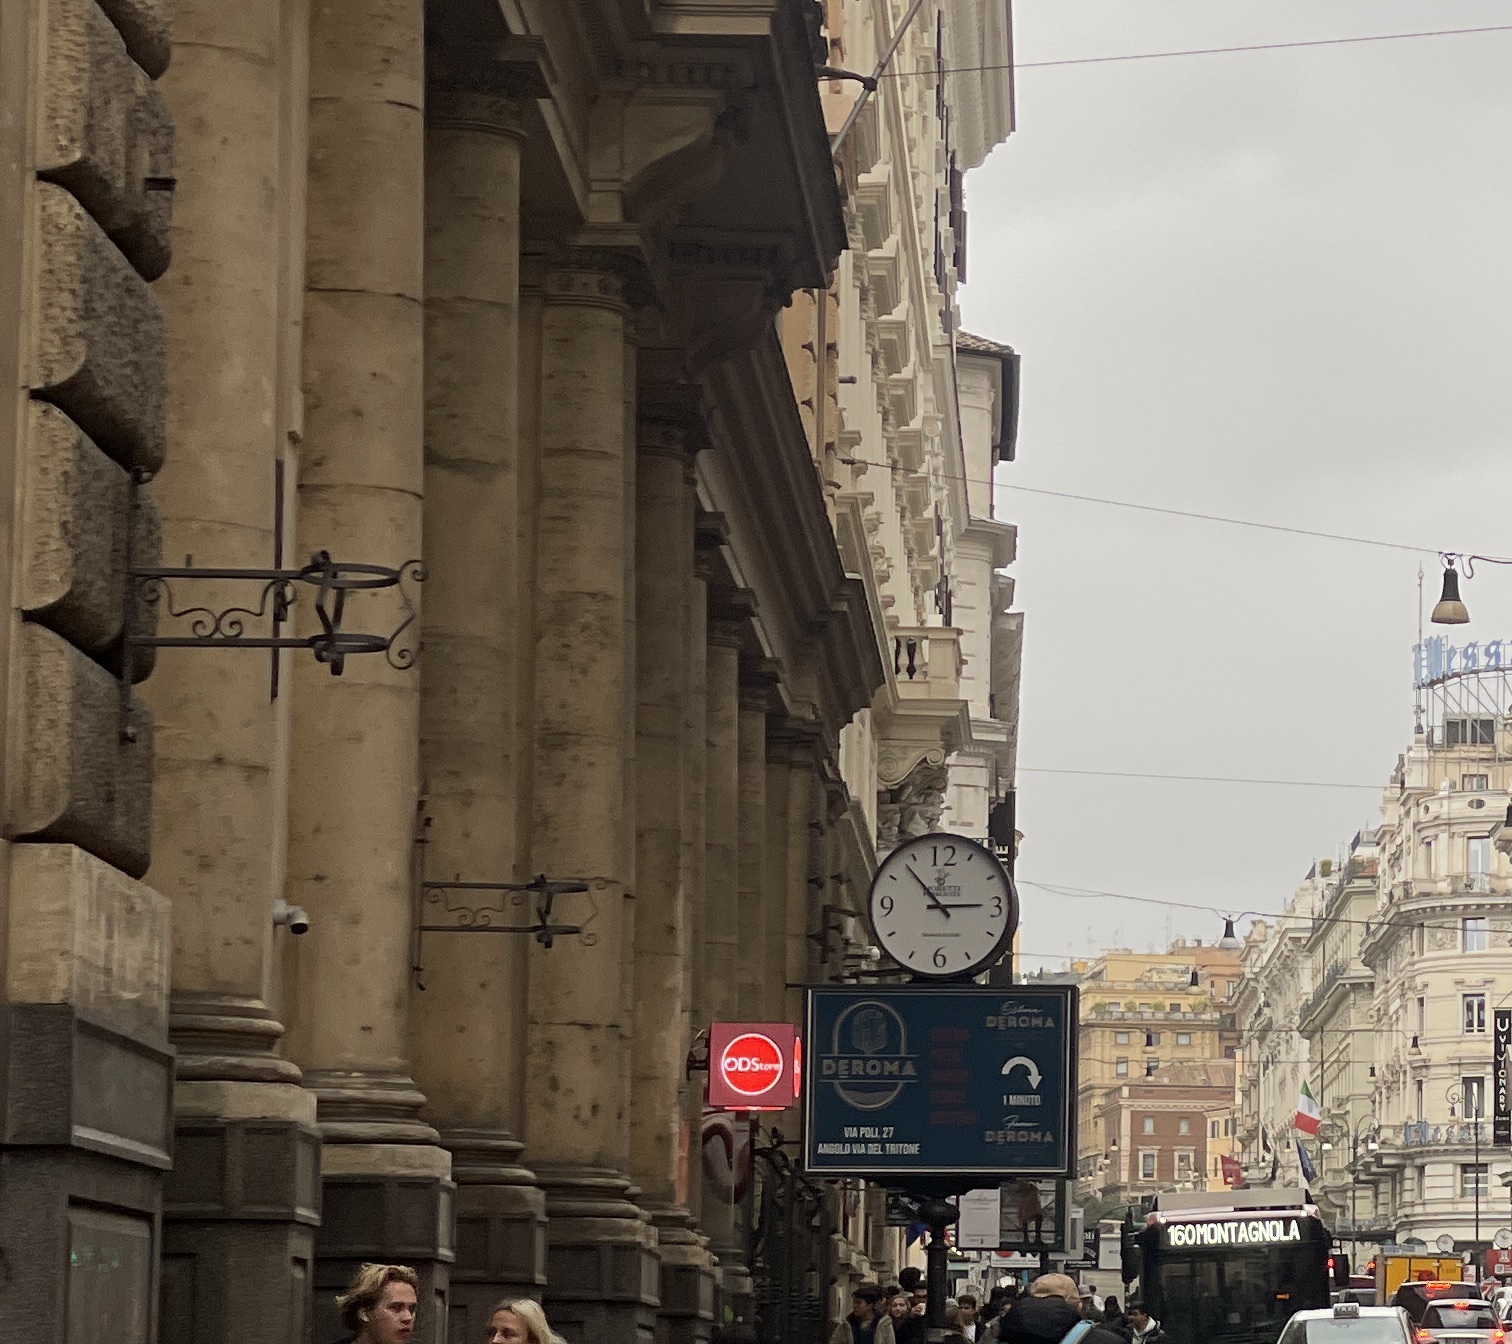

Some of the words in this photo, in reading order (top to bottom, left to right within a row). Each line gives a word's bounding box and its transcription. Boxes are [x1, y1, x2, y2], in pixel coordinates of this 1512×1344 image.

[930, 845, 957, 868] 12
[880, 896, 895, 917] 9
[989, 896, 1002, 918] 3
[933, 947, 947, 968] 6
[822, 1059, 918, 1077] DEROMA
[1003, 1094, 1008, 1106] 1
[843, 1126, 858, 1138] VIA
[882, 1126, 894, 1138] 27
[852, 1143, 866, 1155] VIA
[885, 1143, 920, 1155] TRITONE
